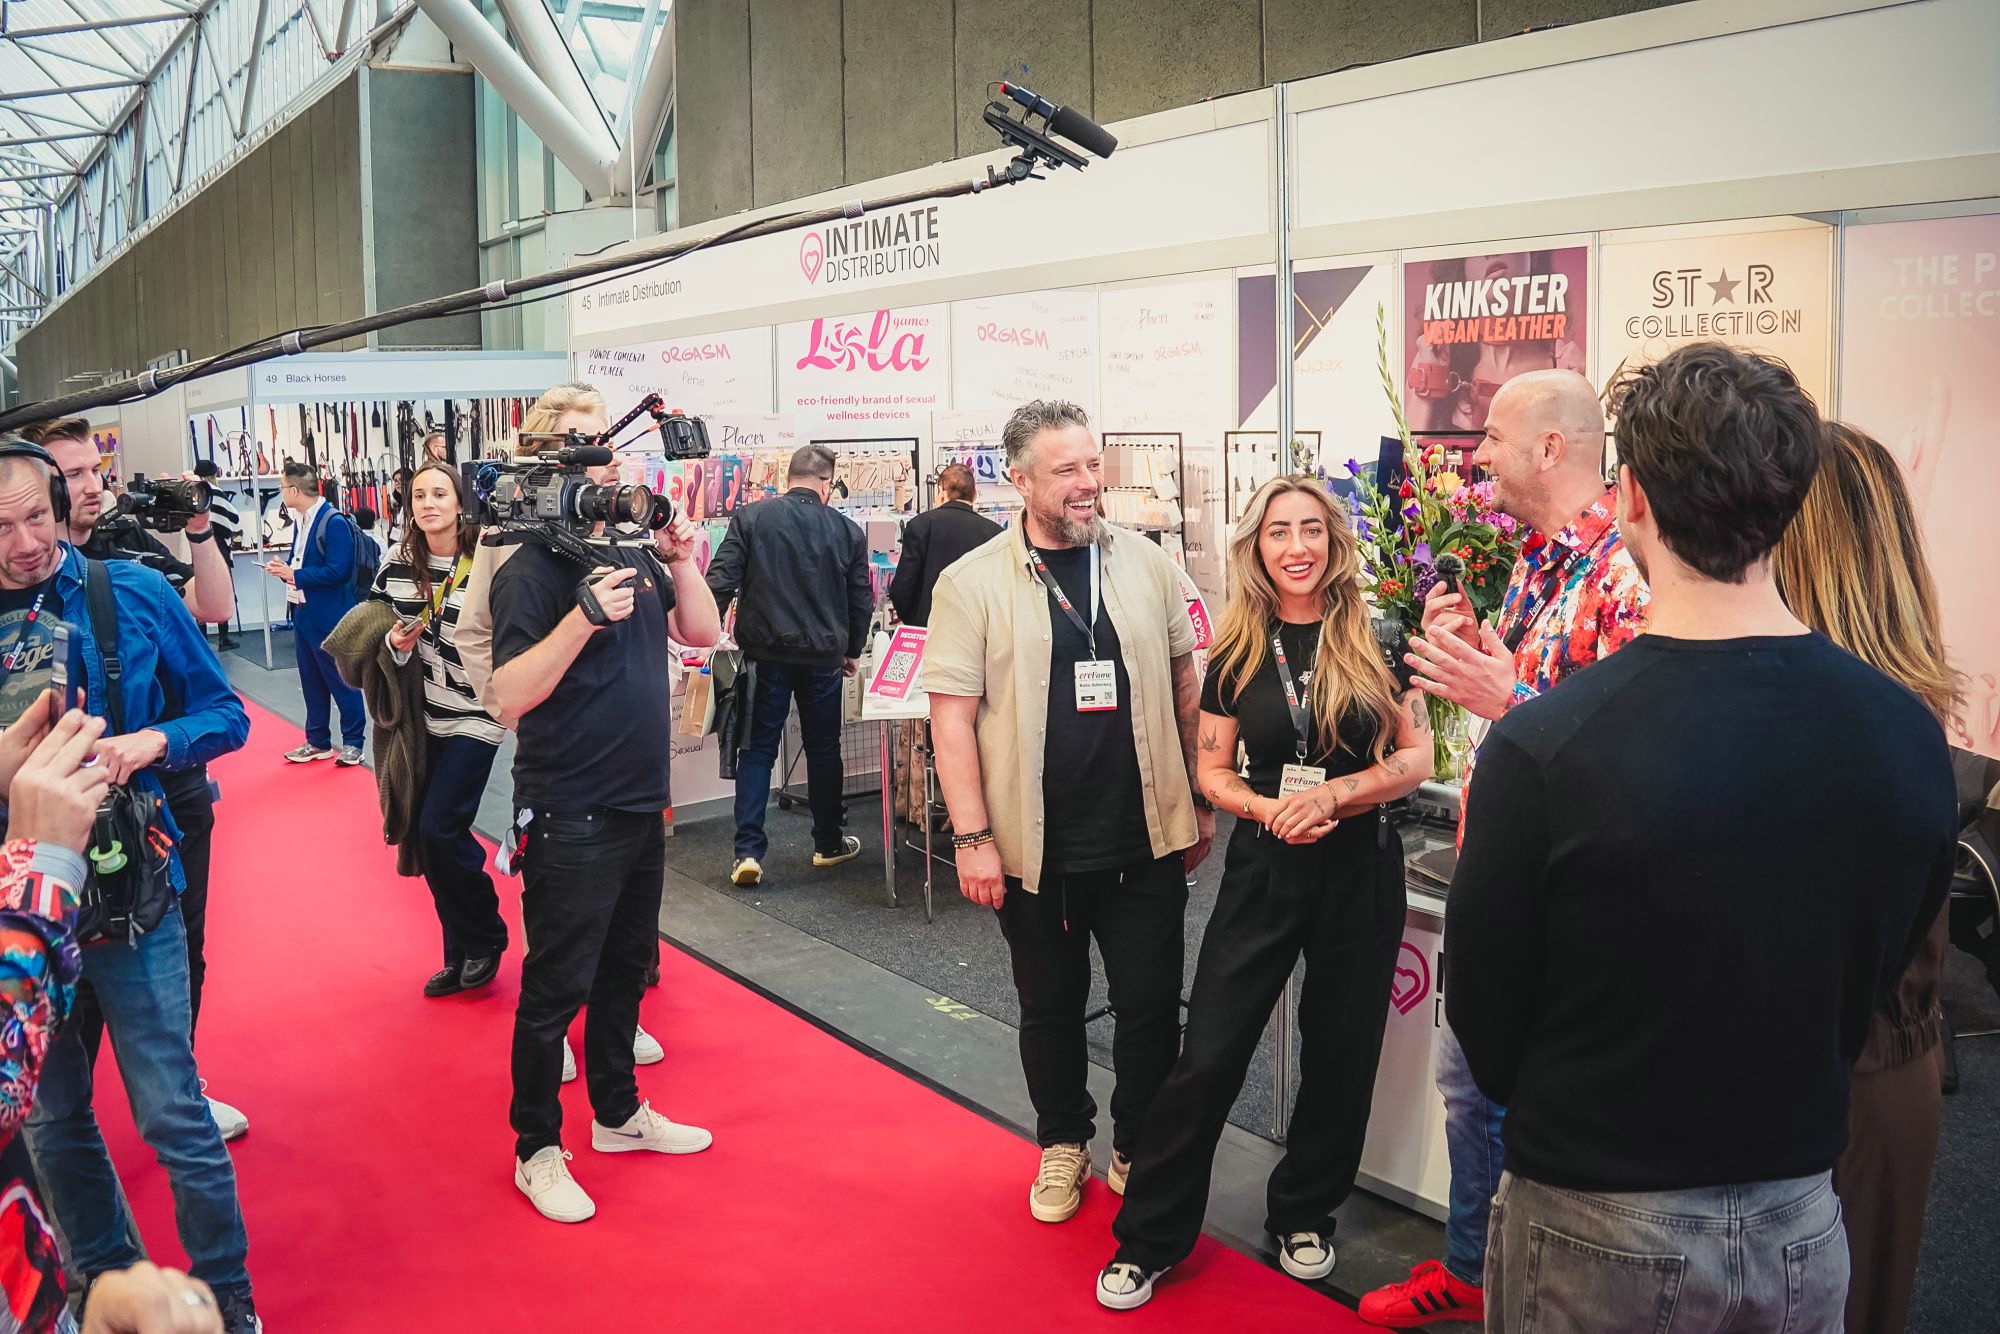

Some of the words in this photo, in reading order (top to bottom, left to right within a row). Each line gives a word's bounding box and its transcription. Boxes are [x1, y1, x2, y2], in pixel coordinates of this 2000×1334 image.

[825, 206, 939, 258] INTIMATE
[826, 242, 940, 283] DISTRIBUTION
[1893, 254, 1960, 289] THE
[582, 295, 592, 310] 45
[598, 289, 630, 308] Intimate
[632, 279, 682, 301] Distribution
[1423, 273, 1569, 321] KINKSTER
[1880, 290, 2000, 320] COLLEC
[893, 316, 930, 330] games
[1423, 318, 1480, 345] VEGAN
[1482, 314, 1567, 343] LEATHER
[1625, 309, 1802, 339] COLLECTION
[977, 322, 1049, 351] ORGASM
[661, 343, 731, 364] ORGASM
[265, 374, 278, 384] 49
[286, 373, 312, 383] Black
[314, 373, 347, 383] Horses
[797, 395, 860, 407] eco-friendly
[862, 395, 892, 405] brand
[893, 395, 903, 404] of
[905, 395, 936, 404] sexual
[826, 410, 870, 420] wellness
[872, 410, 910, 419] devices
[721, 425, 766, 448] Placer
[955, 424, 998, 441] SEXUAL
[900, 631, 929, 641] REGISTER
[1190, 609, 1207, 643] 10%
[901, 641, 918, 649] HERE
[670, 738, 704, 760] Sexual
